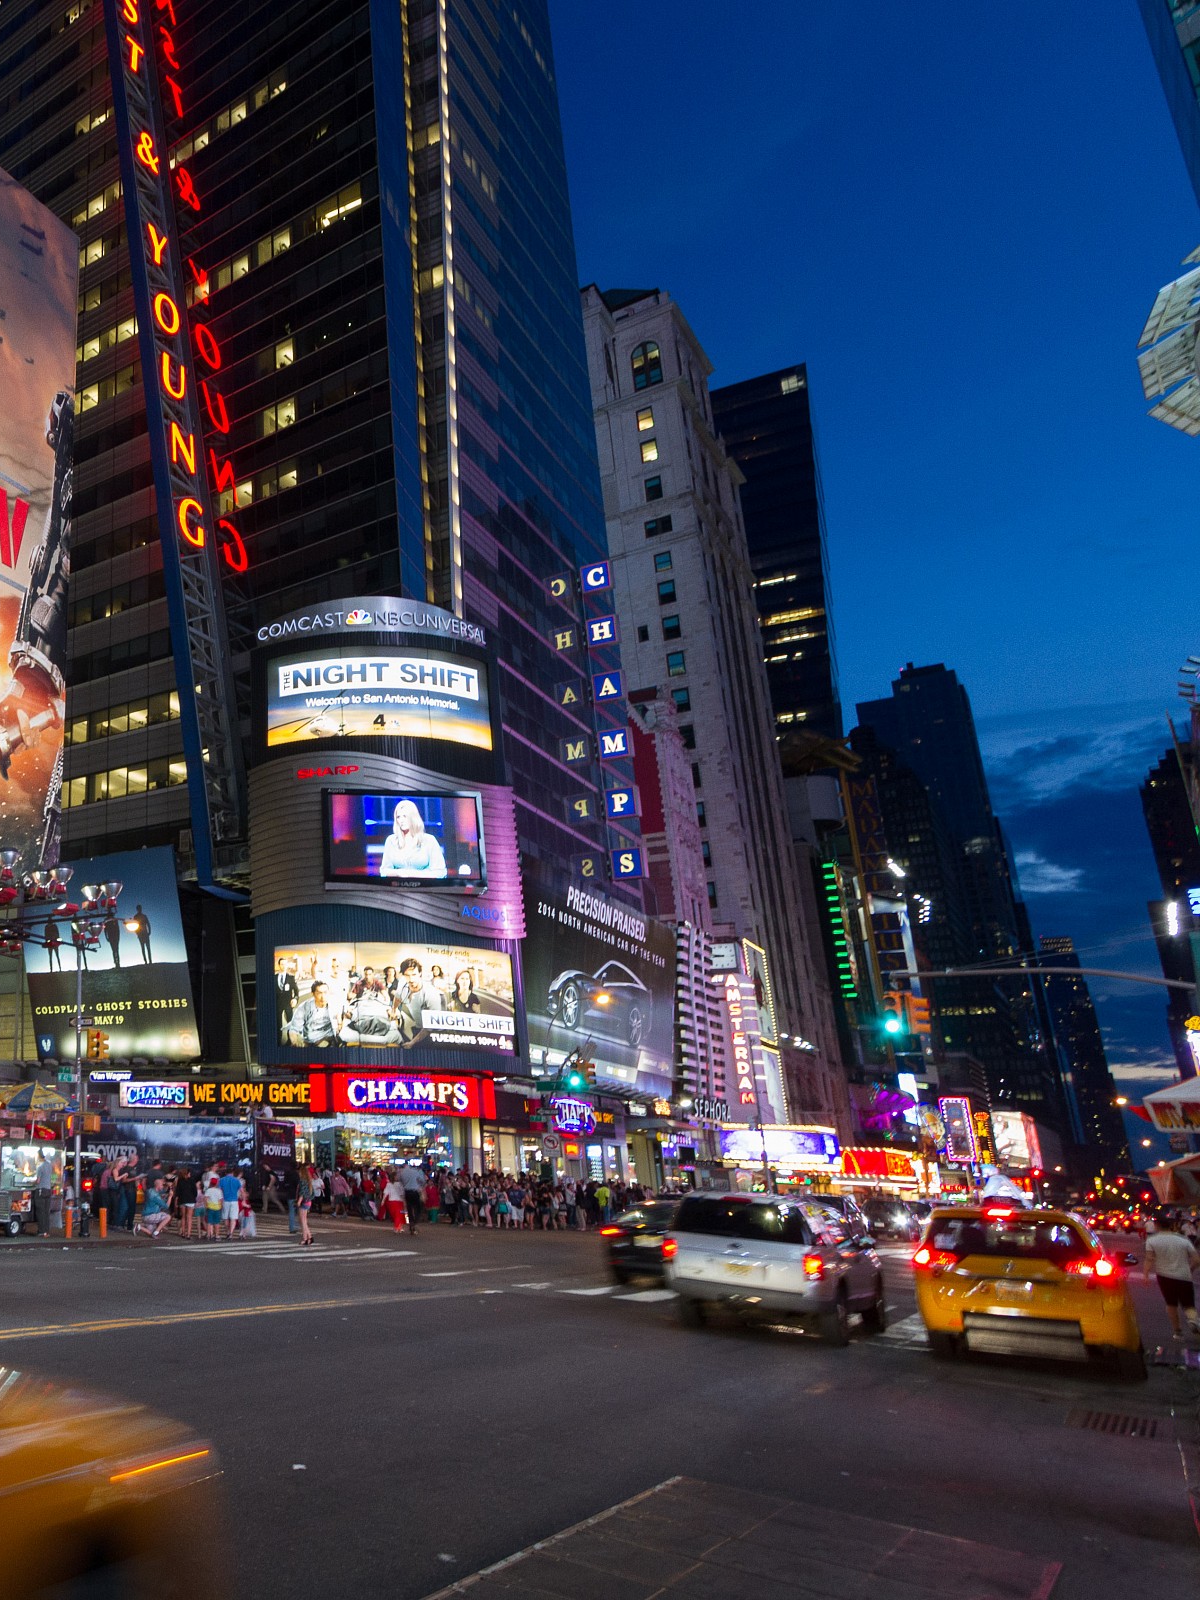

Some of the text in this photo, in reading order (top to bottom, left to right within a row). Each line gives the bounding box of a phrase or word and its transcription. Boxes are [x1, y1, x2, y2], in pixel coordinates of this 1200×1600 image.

[137, 132, 159, 174] &
[147, 222, 205, 548] YOUNG
[258, 610, 487, 646] COMCAST NBCUNIVERSAL
[292, 662, 475, 692] NIGHT SHIFT
[305, 695, 349, 708] Welcome
[351, 694, 361, 704] to
[363, 693, 382, 704] San
[383, 694, 419, 705] Antonio
[373, 714, 386, 727] 4
[587, 567, 635, 873] CHAMPS
[297, 765, 359, 779] SHARP
[461, 905, 506, 922] AQUOS
[567, 885, 646, 942] PRECISION PRAISED.
[538, 901, 555, 919] 2014
[559, 910, 580, 930] NORTH
[584, 922, 614, 945] AMERICAN
[617, 937, 628, 952] CAR
[631, 943, 638, 955] OF
[640, 948, 650, 961] THE
[35, 998, 188, 1015] COLDPLAY GHOST STORIES
[94, 1016, 114, 1025] MAY
[115, 1015, 124, 1025] 19
[430, 1014, 512, 1031] NIGHT SHIFT
[430, 1033, 476, 1045] TUESDAYS
[725, 974, 755, 1104] AMSTERDAM
[93, 1071, 131, 1082] Van Wagner
[127, 1086, 185, 1104] CHAMPS
[193, 1083, 216, 1102] WE
[221, 1083, 263, 1102] KNOW
[348, 1080, 469, 1111] CHAMPS
[694, 1098, 731, 1122] SEPHORA
